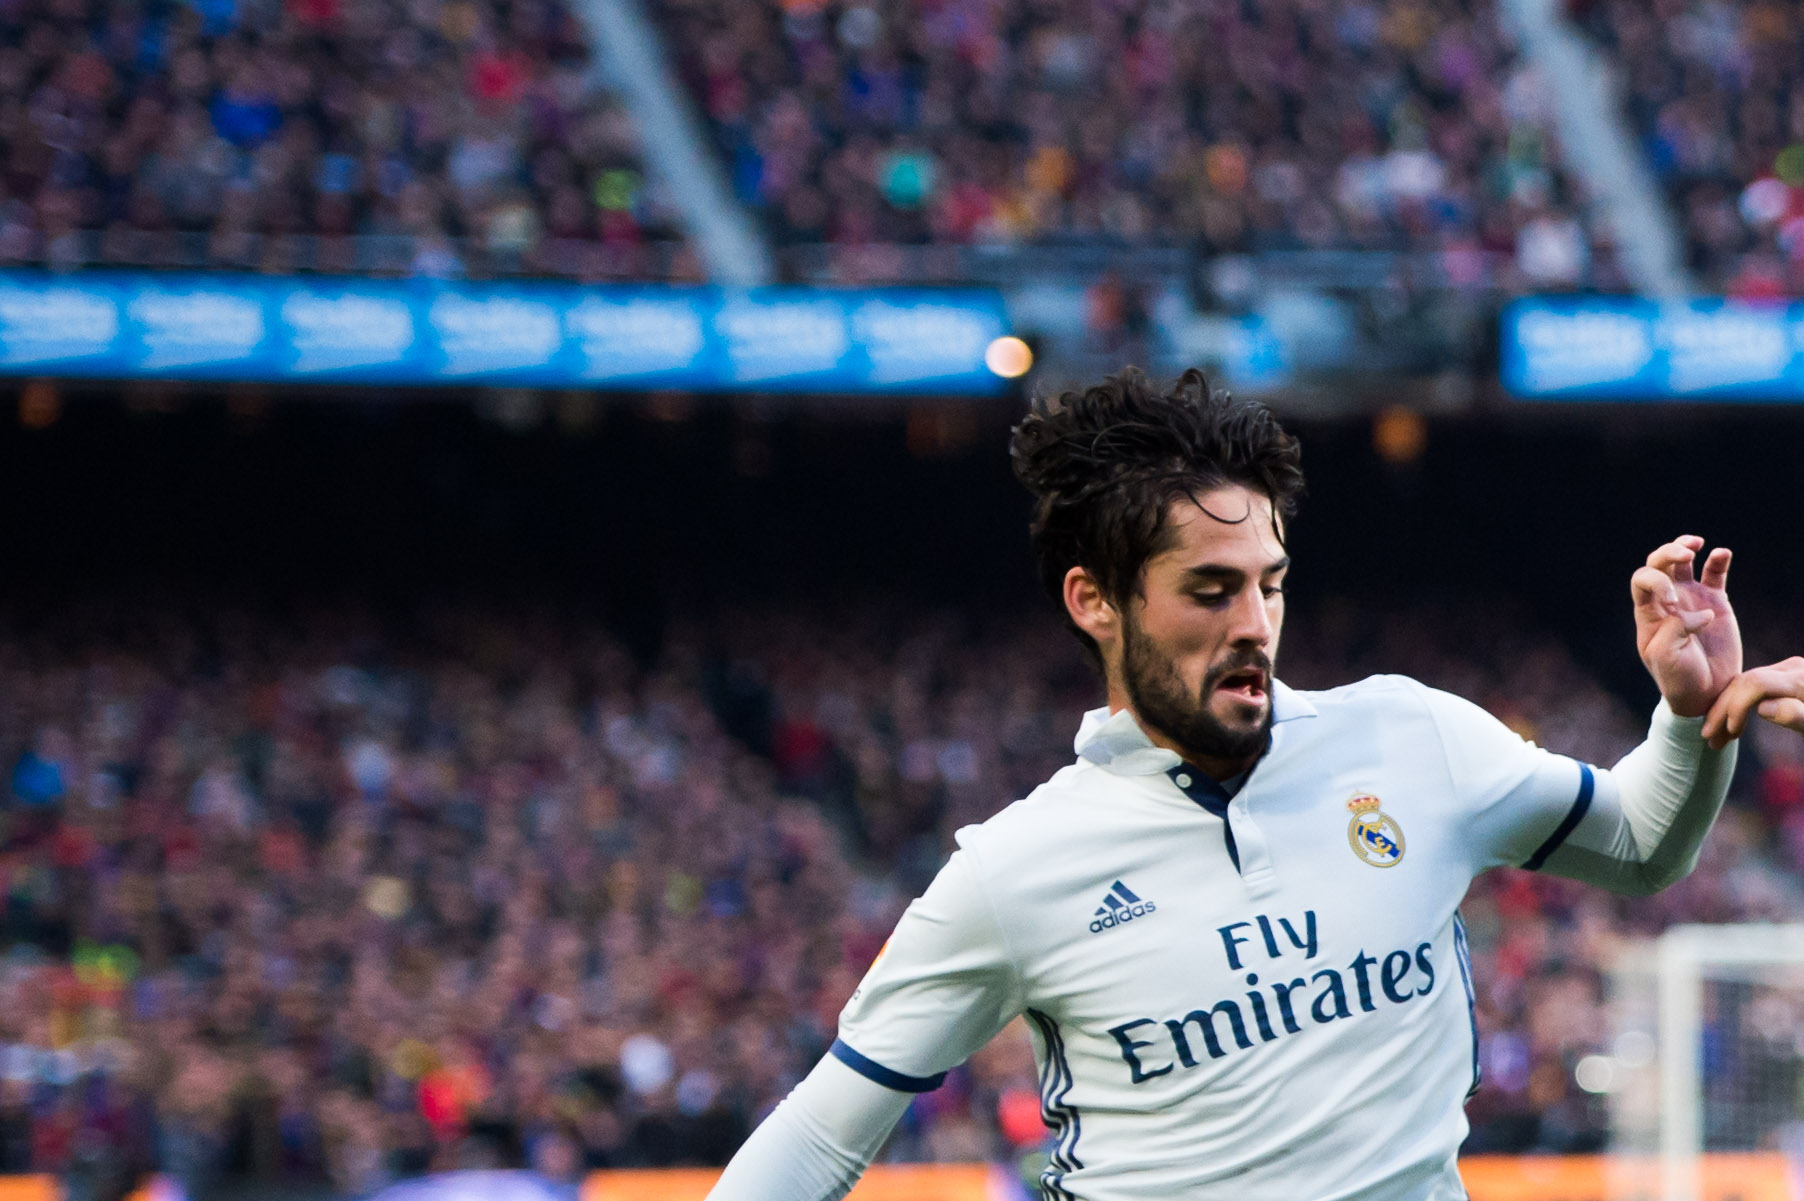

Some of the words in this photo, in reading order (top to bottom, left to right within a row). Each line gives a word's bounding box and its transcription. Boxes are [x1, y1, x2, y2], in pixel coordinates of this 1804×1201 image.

[1089, 901, 1156, 934] adidas
[1216, 910, 1318, 971] Fly
[1107, 942, 1436, 1085] Emirates
